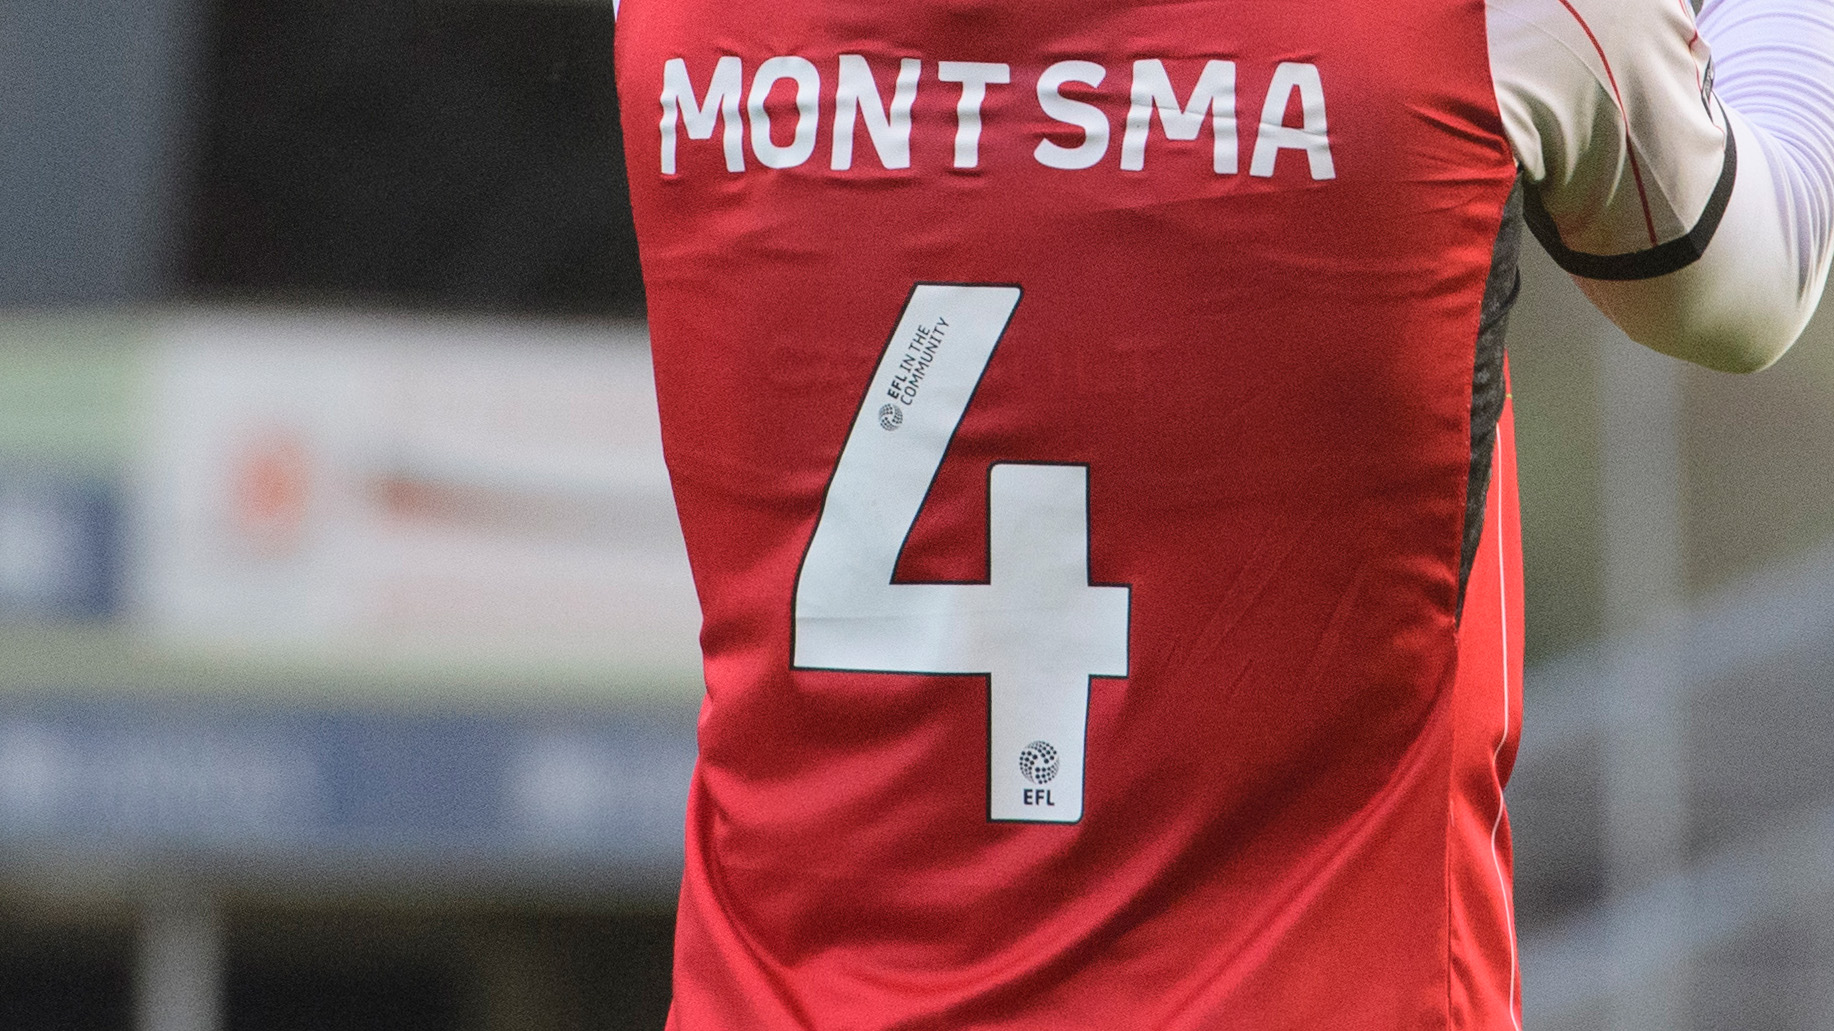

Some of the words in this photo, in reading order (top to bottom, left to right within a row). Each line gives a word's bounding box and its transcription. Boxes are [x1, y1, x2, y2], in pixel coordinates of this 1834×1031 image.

[659, 54, 1336, 180] MONTSMA
[887, 374, 908, 399] EFL
[899, 353, 916, 373] IN
[908, 324, 930, 352] THE
[900, 317, 949, 405] COMMUNITY
[792, 283, 1131, 824] 4
[1023, 788, 1055, 807] EFL
